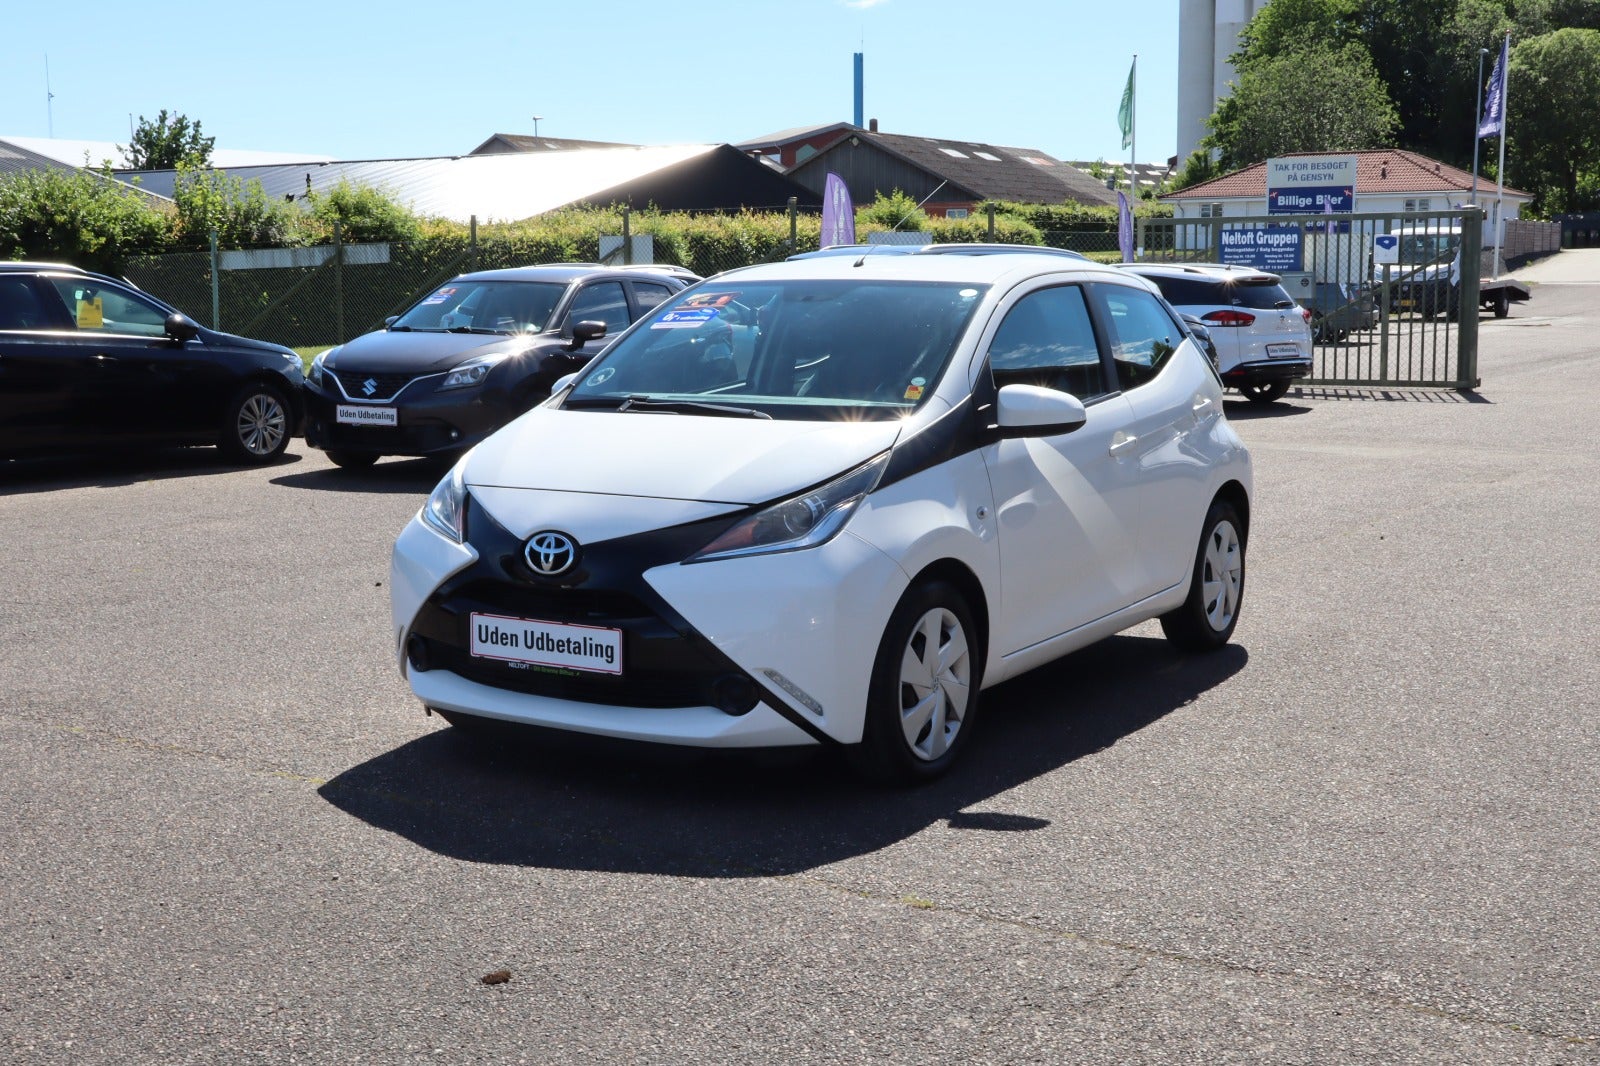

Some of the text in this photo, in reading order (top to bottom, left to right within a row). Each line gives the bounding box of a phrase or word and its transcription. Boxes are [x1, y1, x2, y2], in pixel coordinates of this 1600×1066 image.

[1274, 161, 1349, 171] TAK FOR BESØGET
[1287, 173, 1334, 182] PÅ GENSYN
[1277, 196, 1312, 208] Billige
[1221, 231, 1298, 247] Neltoft Gruppen
[339, 409, 395, 421] Uden Udbetaling
[478, 624, 614, 664] Uden Udbetaling
